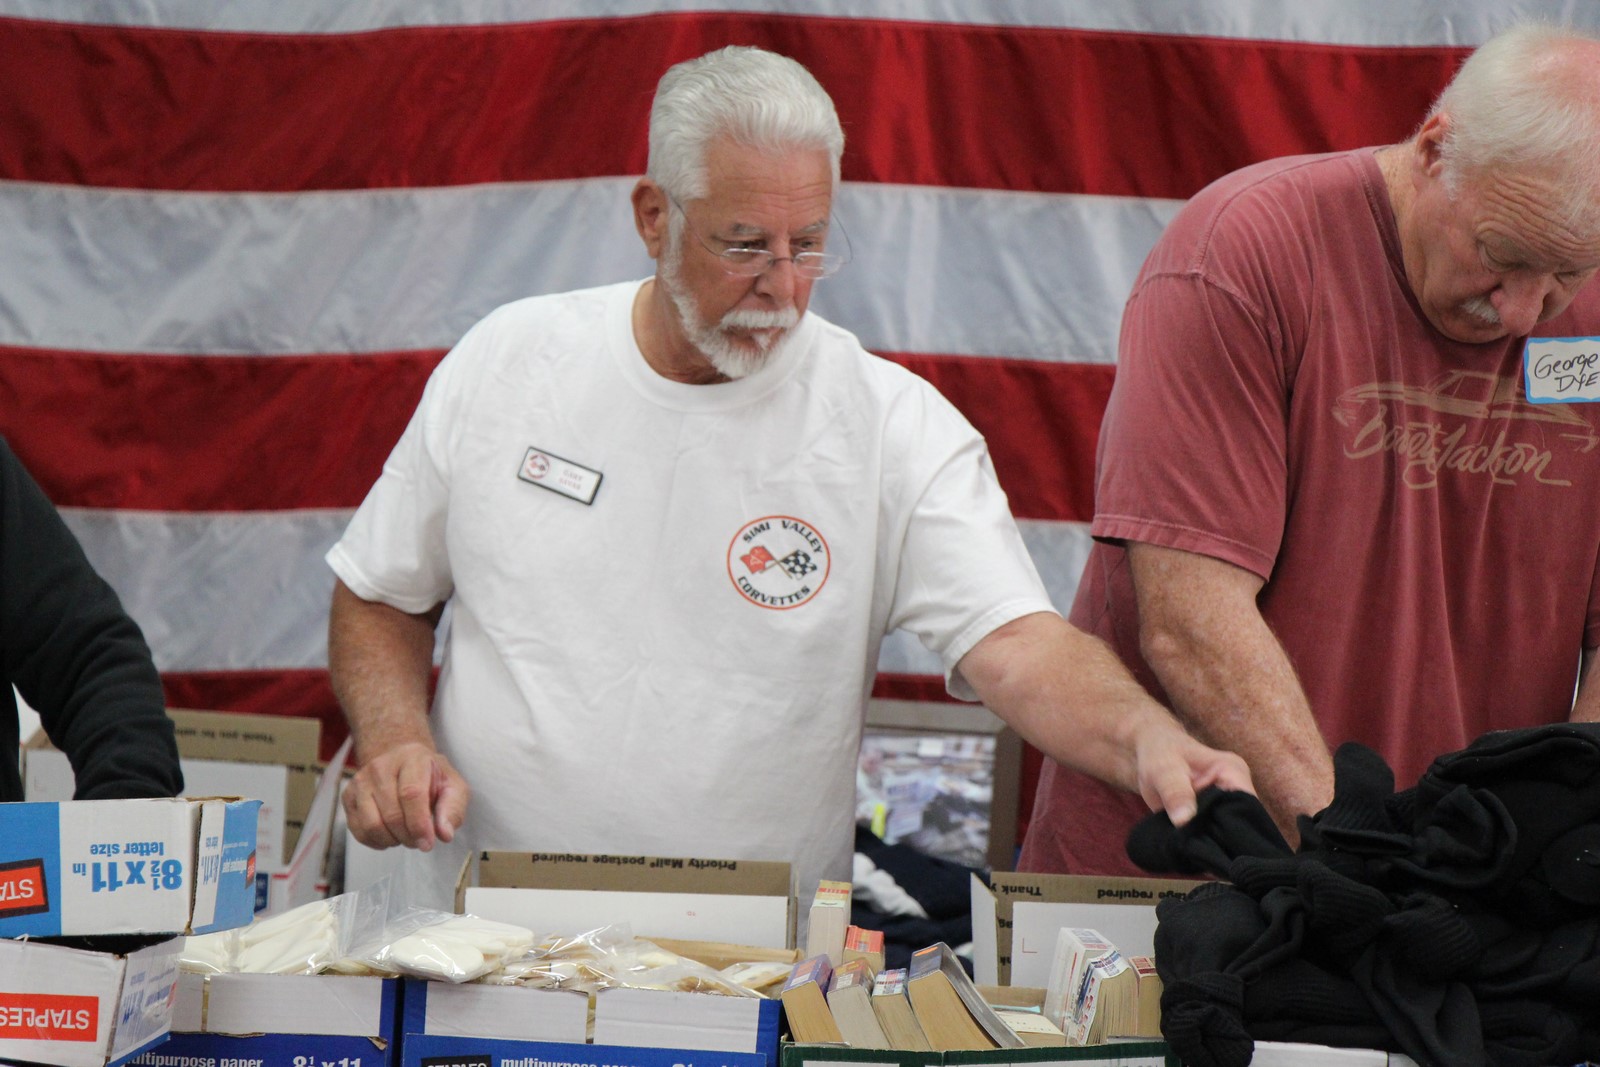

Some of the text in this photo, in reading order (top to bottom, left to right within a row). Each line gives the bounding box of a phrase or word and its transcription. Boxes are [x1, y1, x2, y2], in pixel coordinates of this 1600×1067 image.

[1534, 353, 1599, 379] George
[743, 519, 822, 552] SIMI VALLEY
[738, 575, 811, 605] CORVETTES
[90, 841, 164, 857] letter size
[532, 853, 588, 863] required
[593, 854, 646, 865] postage
[688, 858, 737, 870] Priority
[73, 862, 86, 877] in
[92, 861, 123, 892] 11
[1002, 884, 1042, 896] Thank
[1097, 888, 1153, 900] required
[0, 1006, 90, 1030] STAPLES
